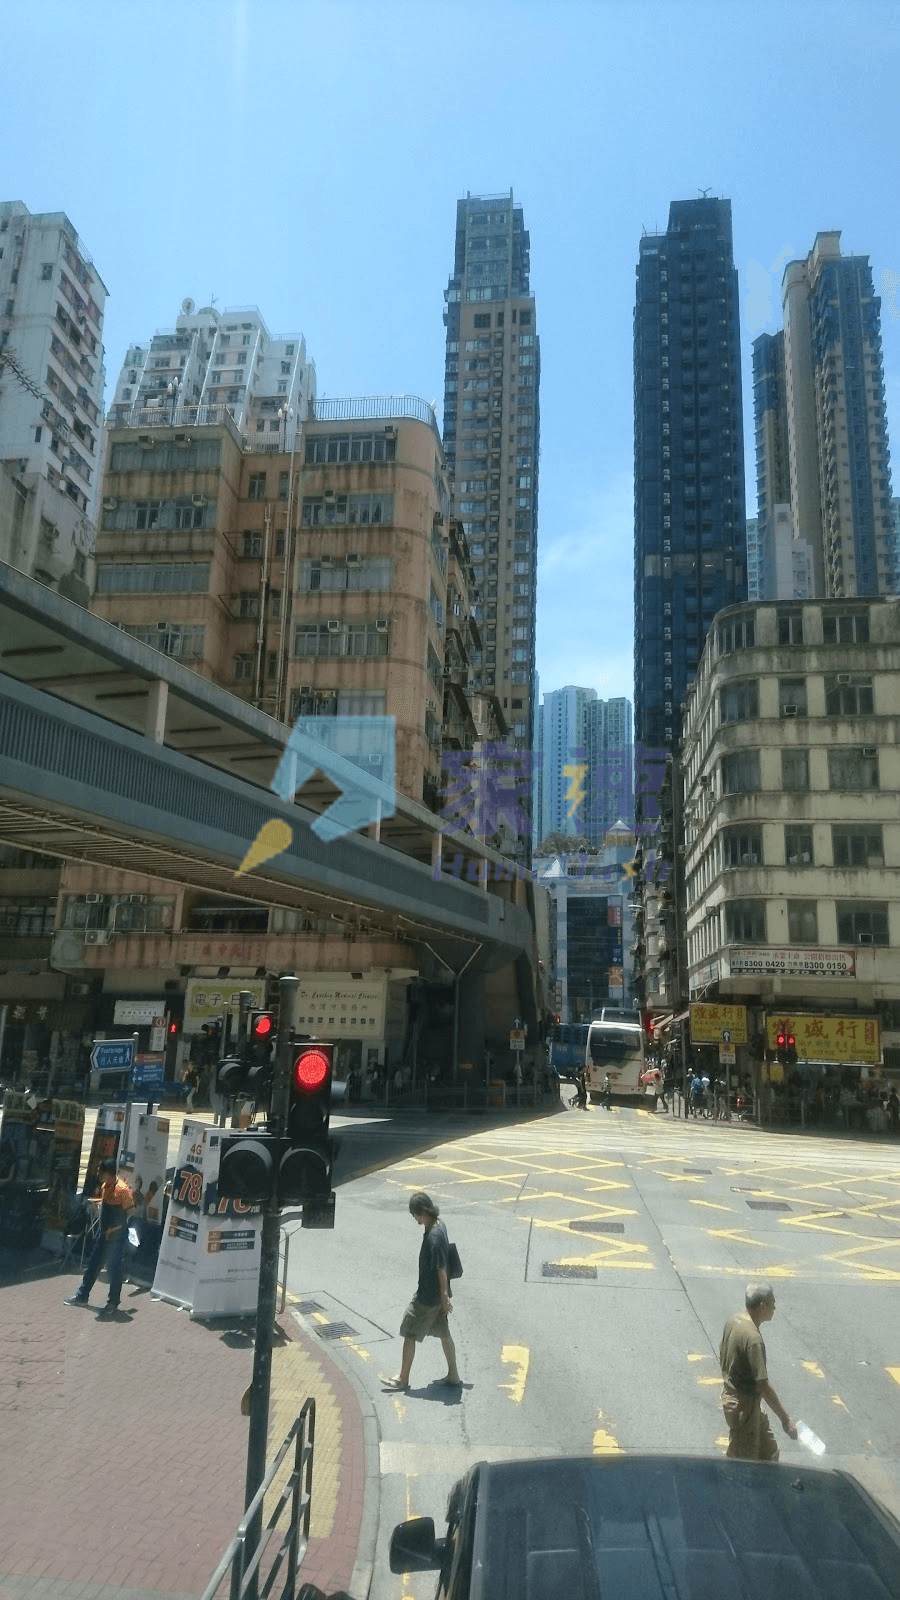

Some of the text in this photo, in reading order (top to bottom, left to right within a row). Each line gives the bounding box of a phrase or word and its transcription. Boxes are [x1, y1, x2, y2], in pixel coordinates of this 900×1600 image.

[765, 960, 785, 968] 0420
[804, 961, 824, 969] 8300
[100, 1055, 124, 1065] 行人天橋
[190, 1143, 202, 1155] 4G
